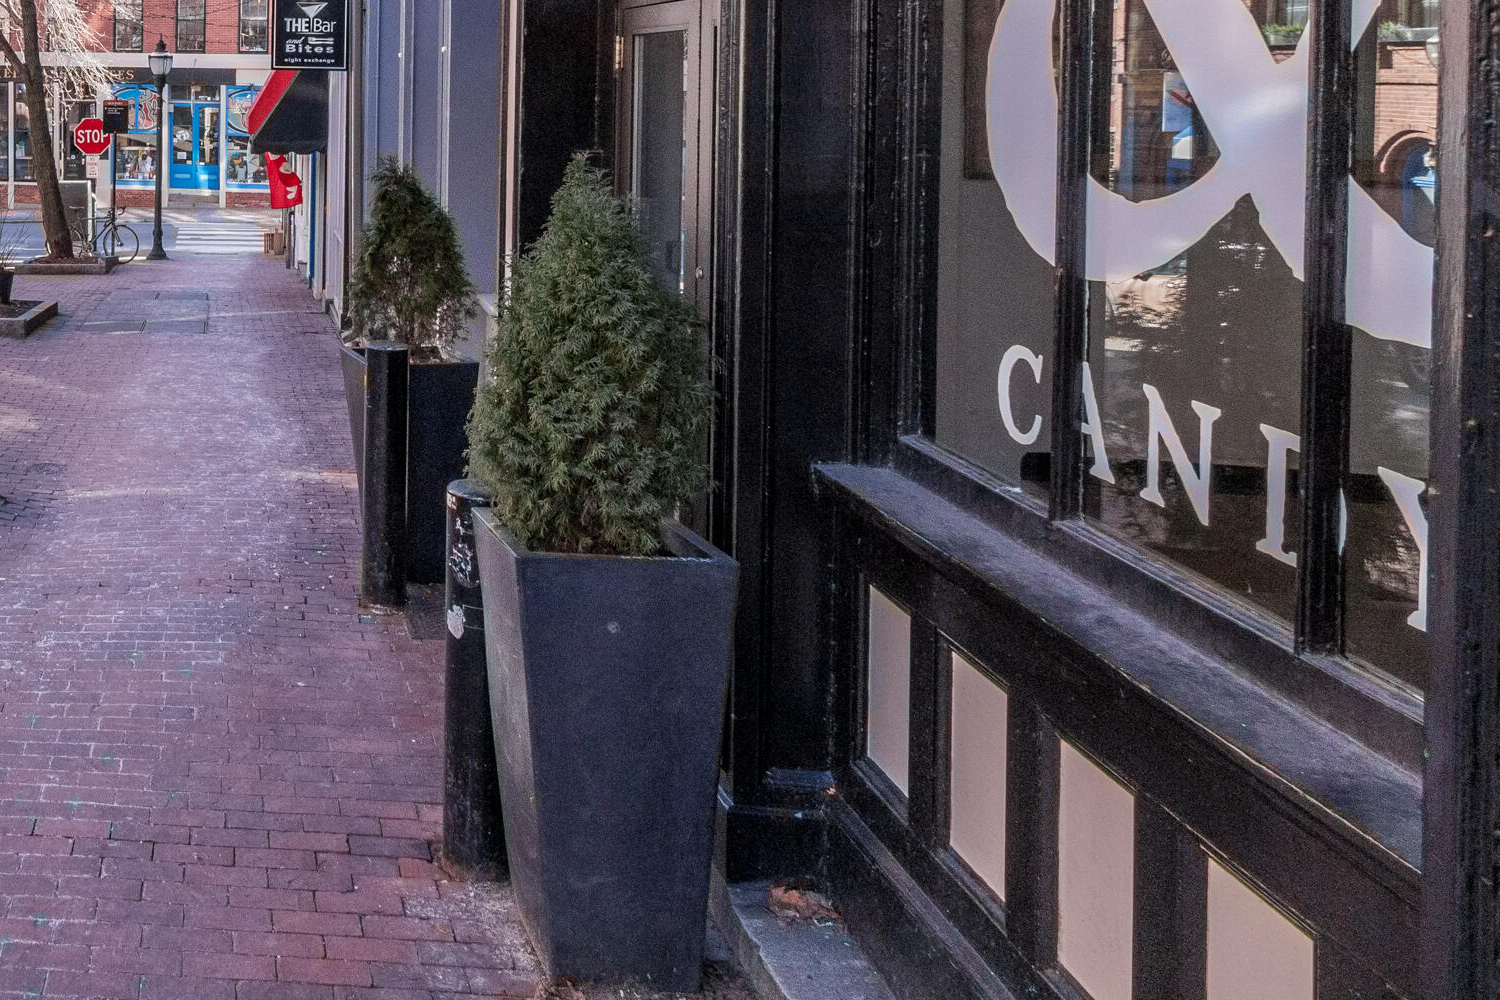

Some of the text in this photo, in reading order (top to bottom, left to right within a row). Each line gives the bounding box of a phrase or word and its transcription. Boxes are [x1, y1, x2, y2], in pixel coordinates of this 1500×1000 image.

[284, 18, 337, 32] THE Bar
[286, 36, 305, 44] and
[285, 44, 334, 53] Bites
[77, 129, 109, 143] STOP
